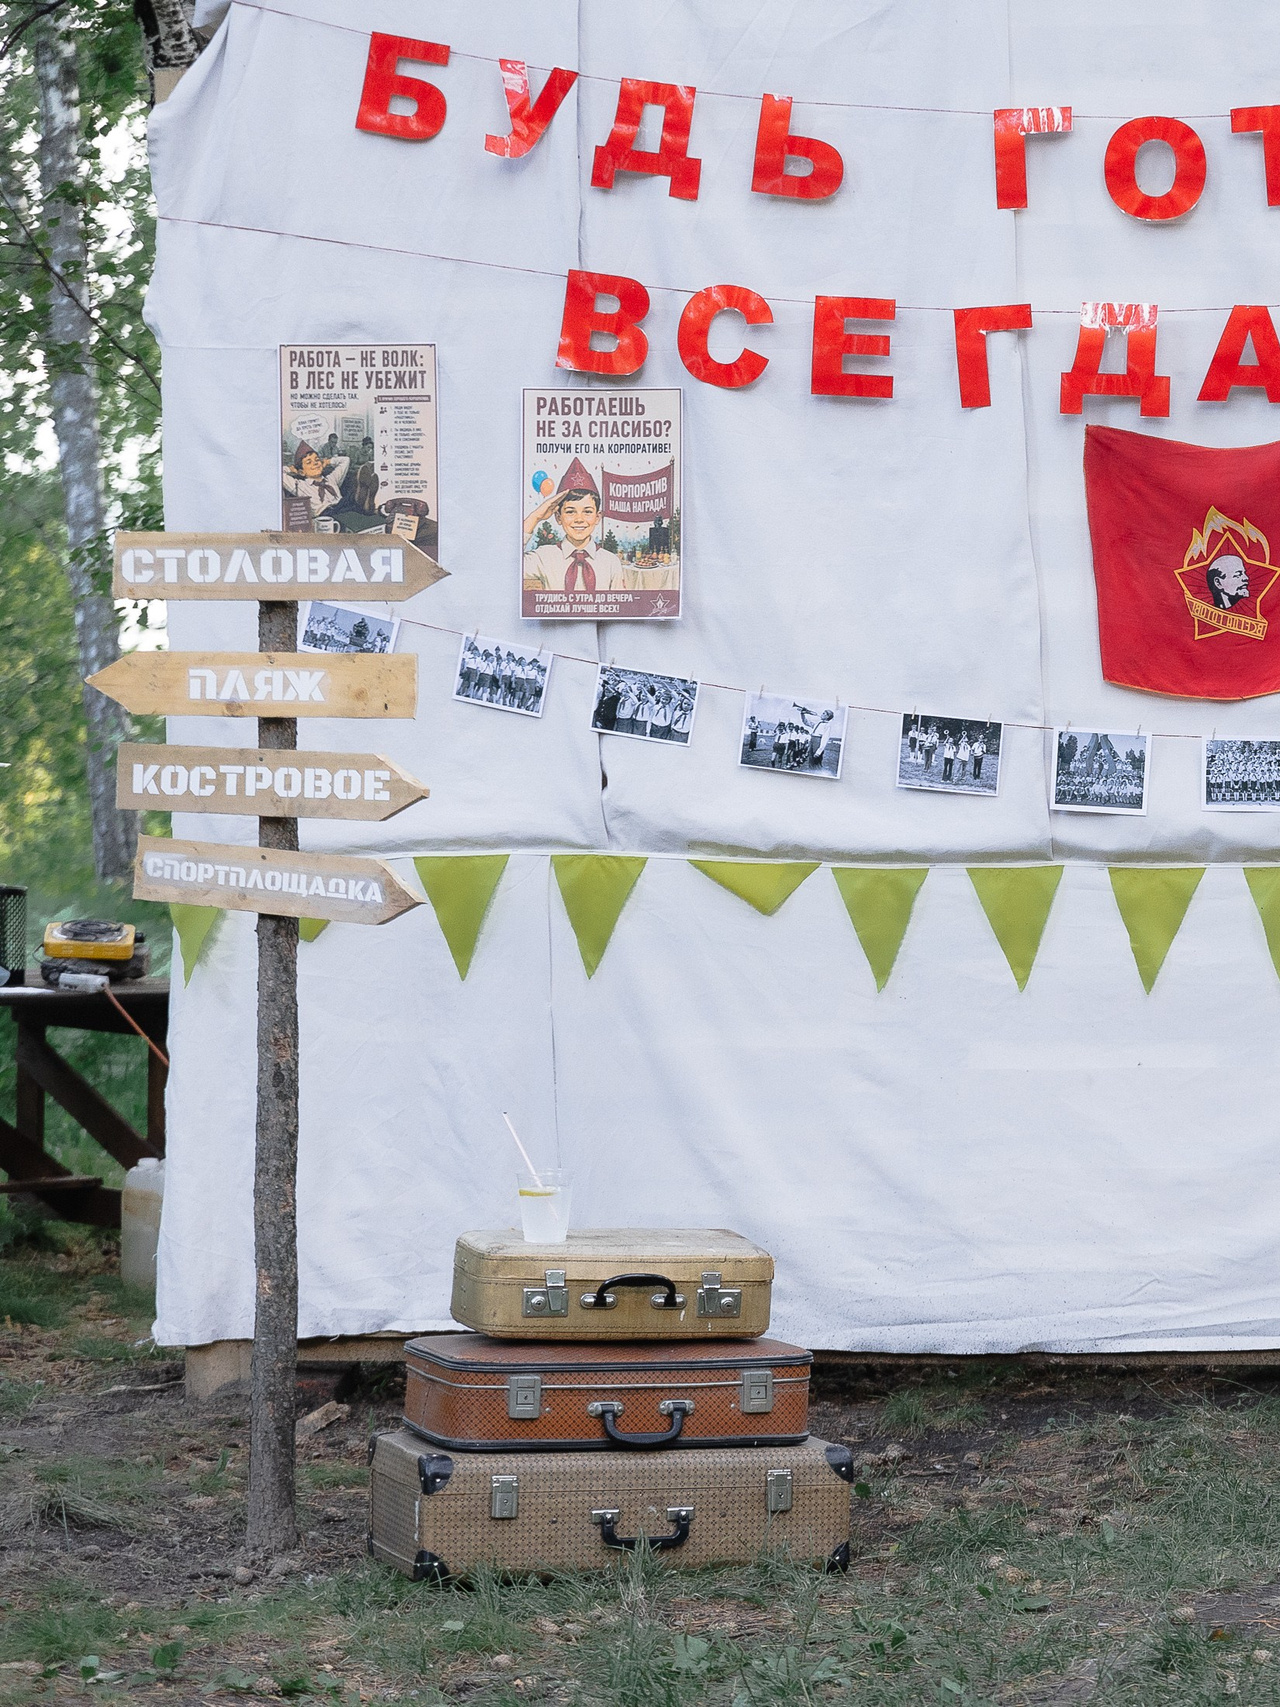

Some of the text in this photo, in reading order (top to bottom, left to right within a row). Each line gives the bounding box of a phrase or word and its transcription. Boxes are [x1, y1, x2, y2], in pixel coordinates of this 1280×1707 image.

[355, 31, 844, 200] БУДЬ
[289, 350, 341, 367] РАБОТА
[360, 350, 376, 367] НЕ
[382, 349, 424, 367] ВОЛК:
[290, 370, 426, 389] В ЛЕС НЕ УБЕЖИТ
[536, 396, 646, 416] РАБОТАЕШЬ
[536, 420, 672, 438] НЕ ЗА СПАСИБО?
[536, 443, 671, 454] ПОЛУЧИ ЕГО НА КОРПОРАТИВЕ!
[609, 477, 668, 498] КОРПОРАТИВ
[609, 497, 667, 513] НАША НАГРАДА!
[121, 548, 404, 583] СТОЛОВАЯ
[535, 594, 567, 603] ТРУДИСЬ
[569, 594, 574, 602] С
[575, 594, 593, 602] УТРА
[595, 594, 606, 603] ДО
[608, 594, 633, 602] ВЕЧЕРА
[535, 603, 620, 613] ОТДЫХАЙ ЛУЧШЕ ВСЕХ!
[188, 668, 326, 702] ПЛЯЖ
[132, 763, 391, 801] КОСТРОВОЕ
[146, 857, 383, 904] СПОРТПЛОЩАДКА
